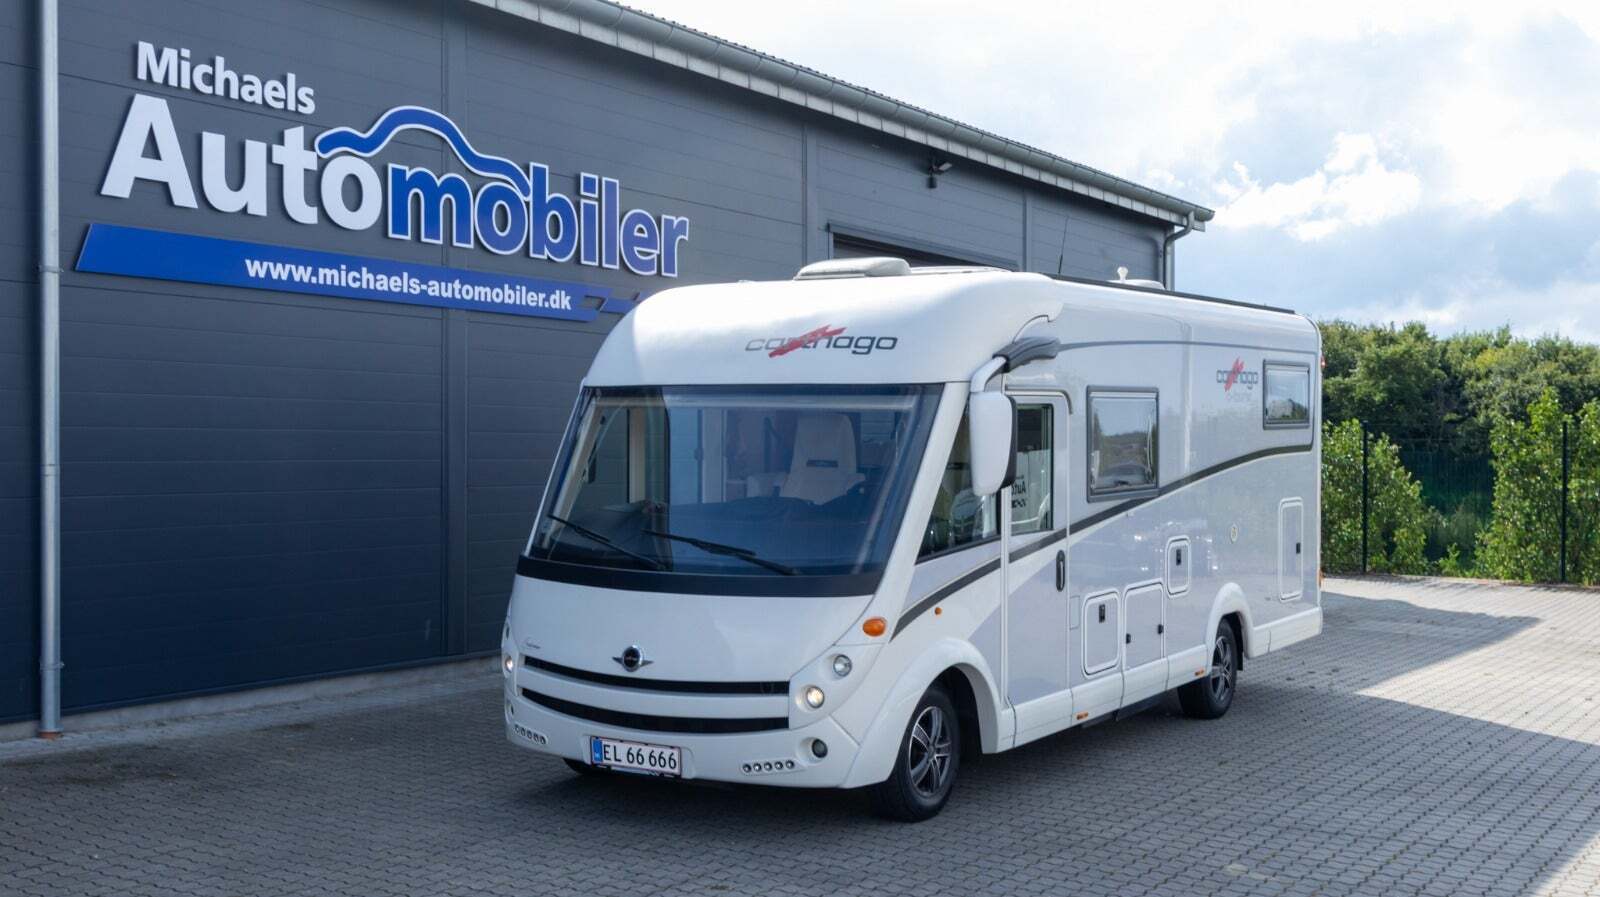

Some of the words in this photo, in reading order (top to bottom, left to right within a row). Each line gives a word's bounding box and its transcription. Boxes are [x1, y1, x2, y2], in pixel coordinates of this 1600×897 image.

[137, 40, 317, 115] Michaels
[100, 93, 690, 279] Automobiler
[244, 258, 573, 311] www.michaels-automobiler.dk
[744, 327, 899, 356] cahago
[1215, 364, 1259, 391] cahago
[603, 744, 622, 762] EL
[626, 746, 645, 765] 66
[648, 749, 677, 770] 666
